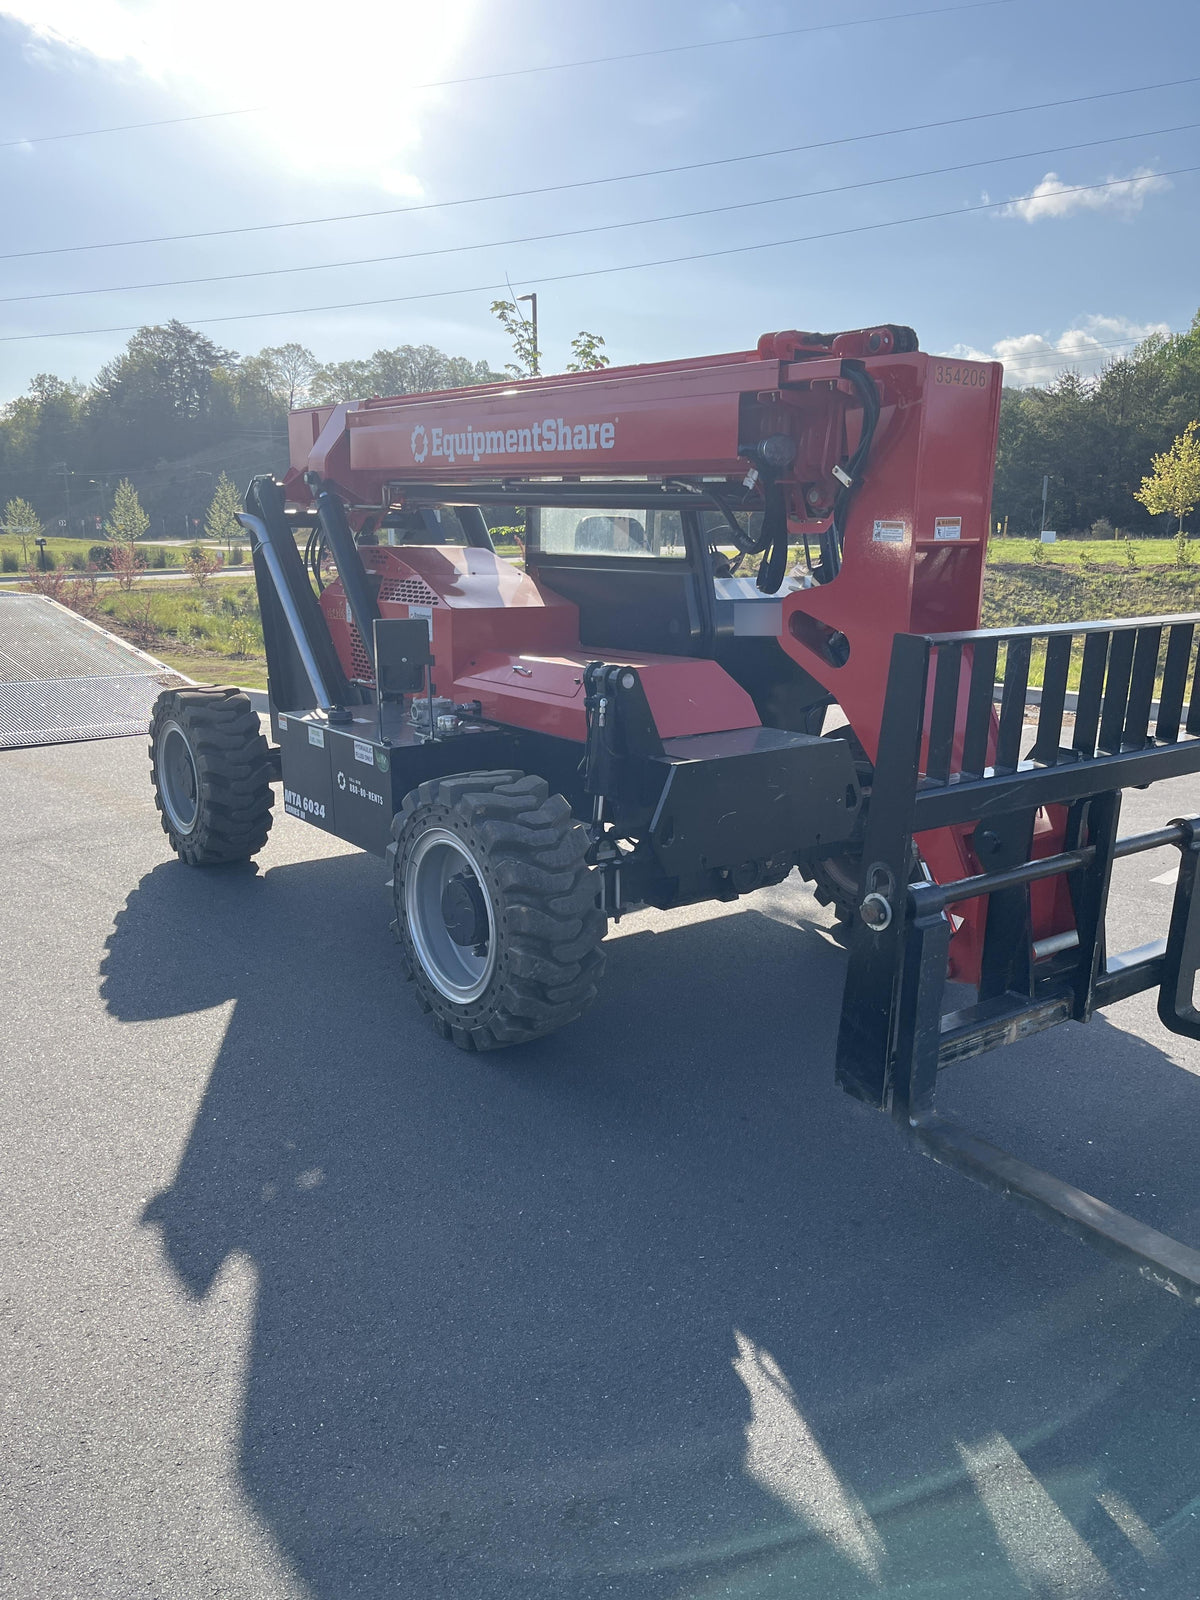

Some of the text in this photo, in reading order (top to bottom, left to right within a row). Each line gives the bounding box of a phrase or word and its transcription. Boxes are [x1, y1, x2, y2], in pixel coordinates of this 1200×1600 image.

[936, 366, 986, 387] 354206
[431, 418, 615, 462] EquipmentShare
[284, 788, 326, 818] MTA 6034
